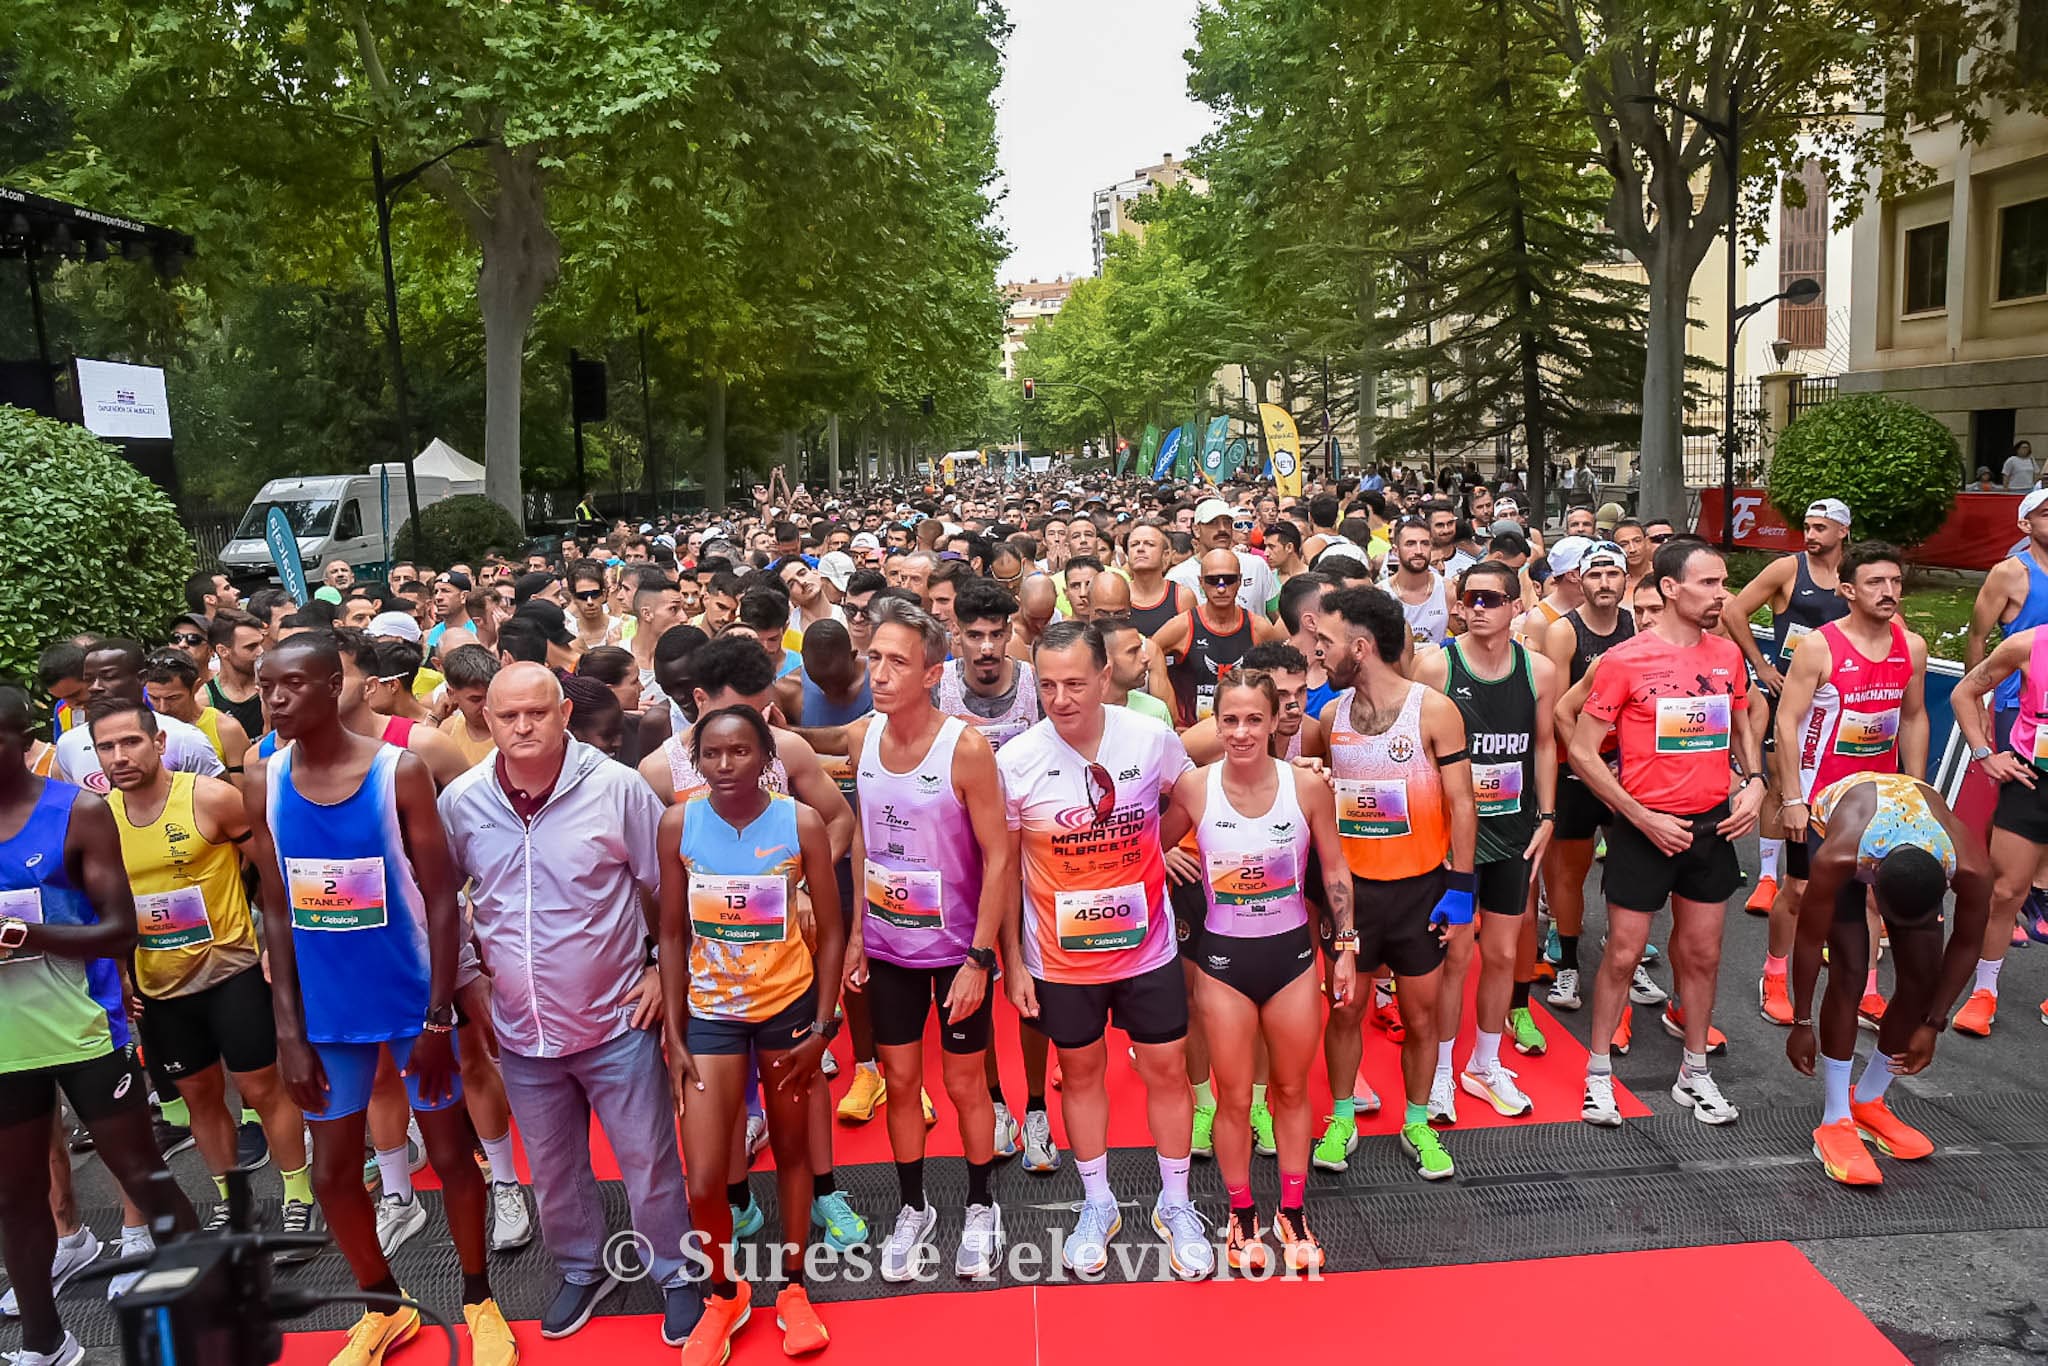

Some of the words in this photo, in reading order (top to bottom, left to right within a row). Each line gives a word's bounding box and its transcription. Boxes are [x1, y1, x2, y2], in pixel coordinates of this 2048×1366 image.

[1686, 712, 1706, 724] 70
[1863, 723, 1883, 735] 163
[1480, 779, 1500, 790] 58
[1357, 797, 1377, 808] 53
[1054, 837, 1139, 856] ALBACETE
[1240, 866, 1265, 880] 25
[324, 880, 337, 894] 2
[885, 885, 908, 900] 20
[1231, 882, 1268, 890] YESICA
[301, 897, 353, 906] STANLEY
[724, 895, 746, 909] 13
[151, 909, 170, 922] 51
[1074, 904, 1131, 920] 4500
